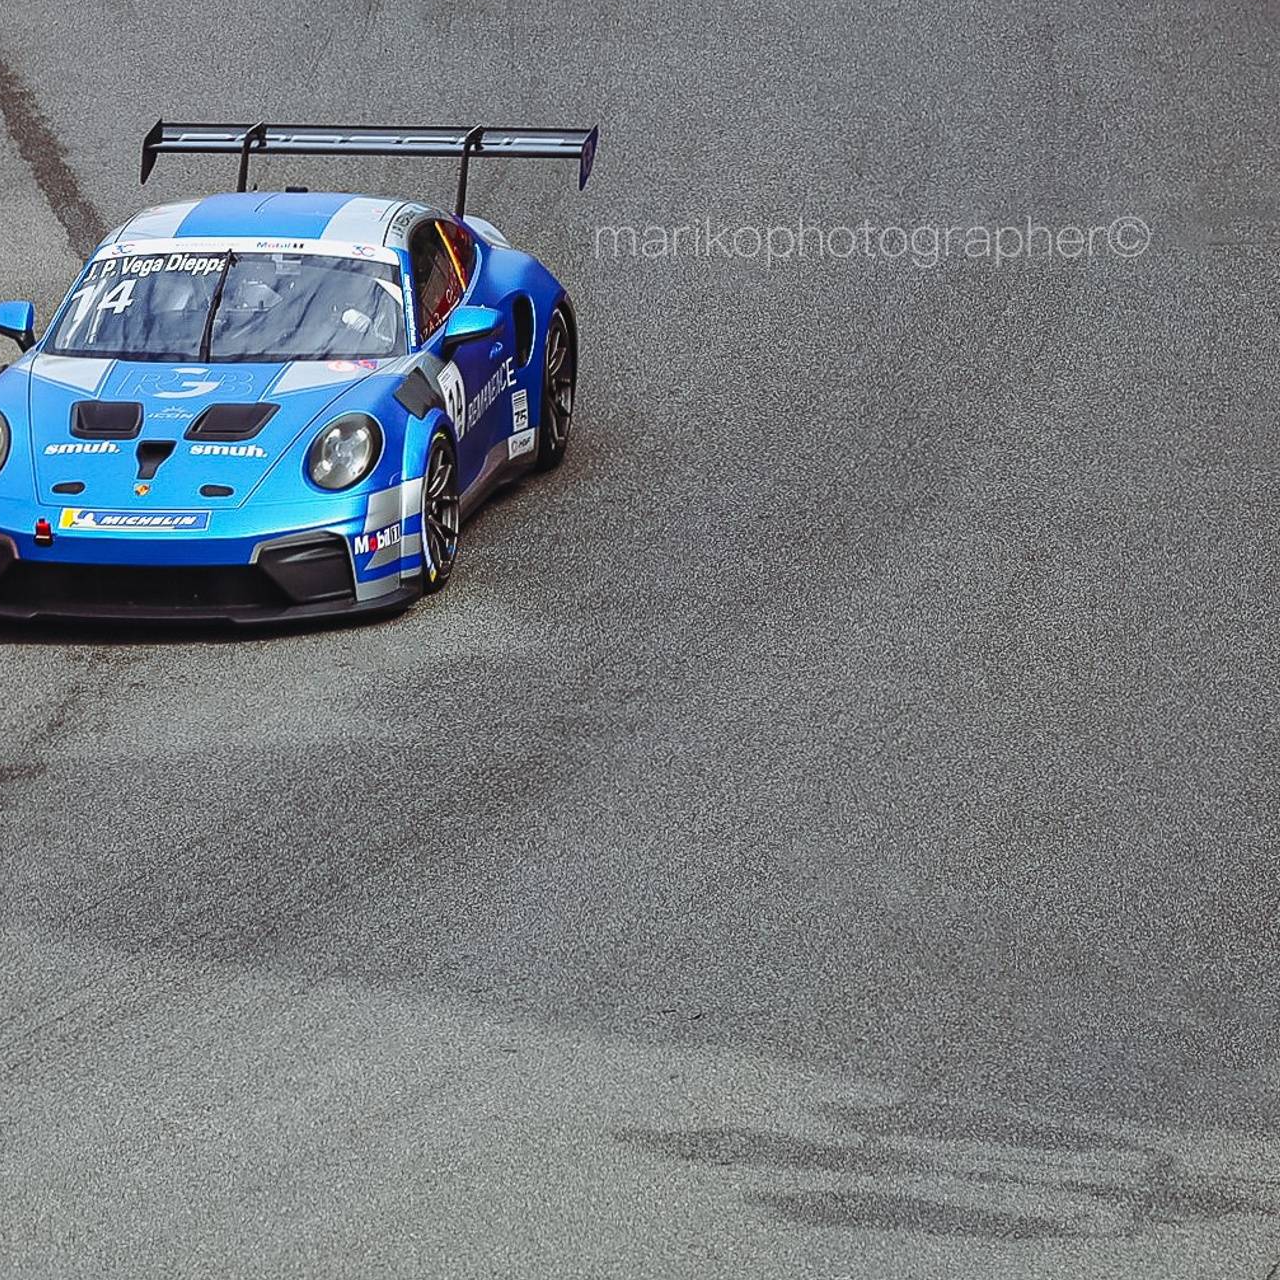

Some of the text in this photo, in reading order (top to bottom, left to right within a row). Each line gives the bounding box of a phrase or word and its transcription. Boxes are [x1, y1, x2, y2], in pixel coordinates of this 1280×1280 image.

[101, 261, 117, 279] P.
[122, 256, 164, 277] Vega
[71, 279, 137, 325] 14
[43, 441, 121, 455] smuh.
[189, 443, 268, 458] smuh.
[100, 515, 197, 526] MICHELIN
[354, 528, 391, 556] Mobil
